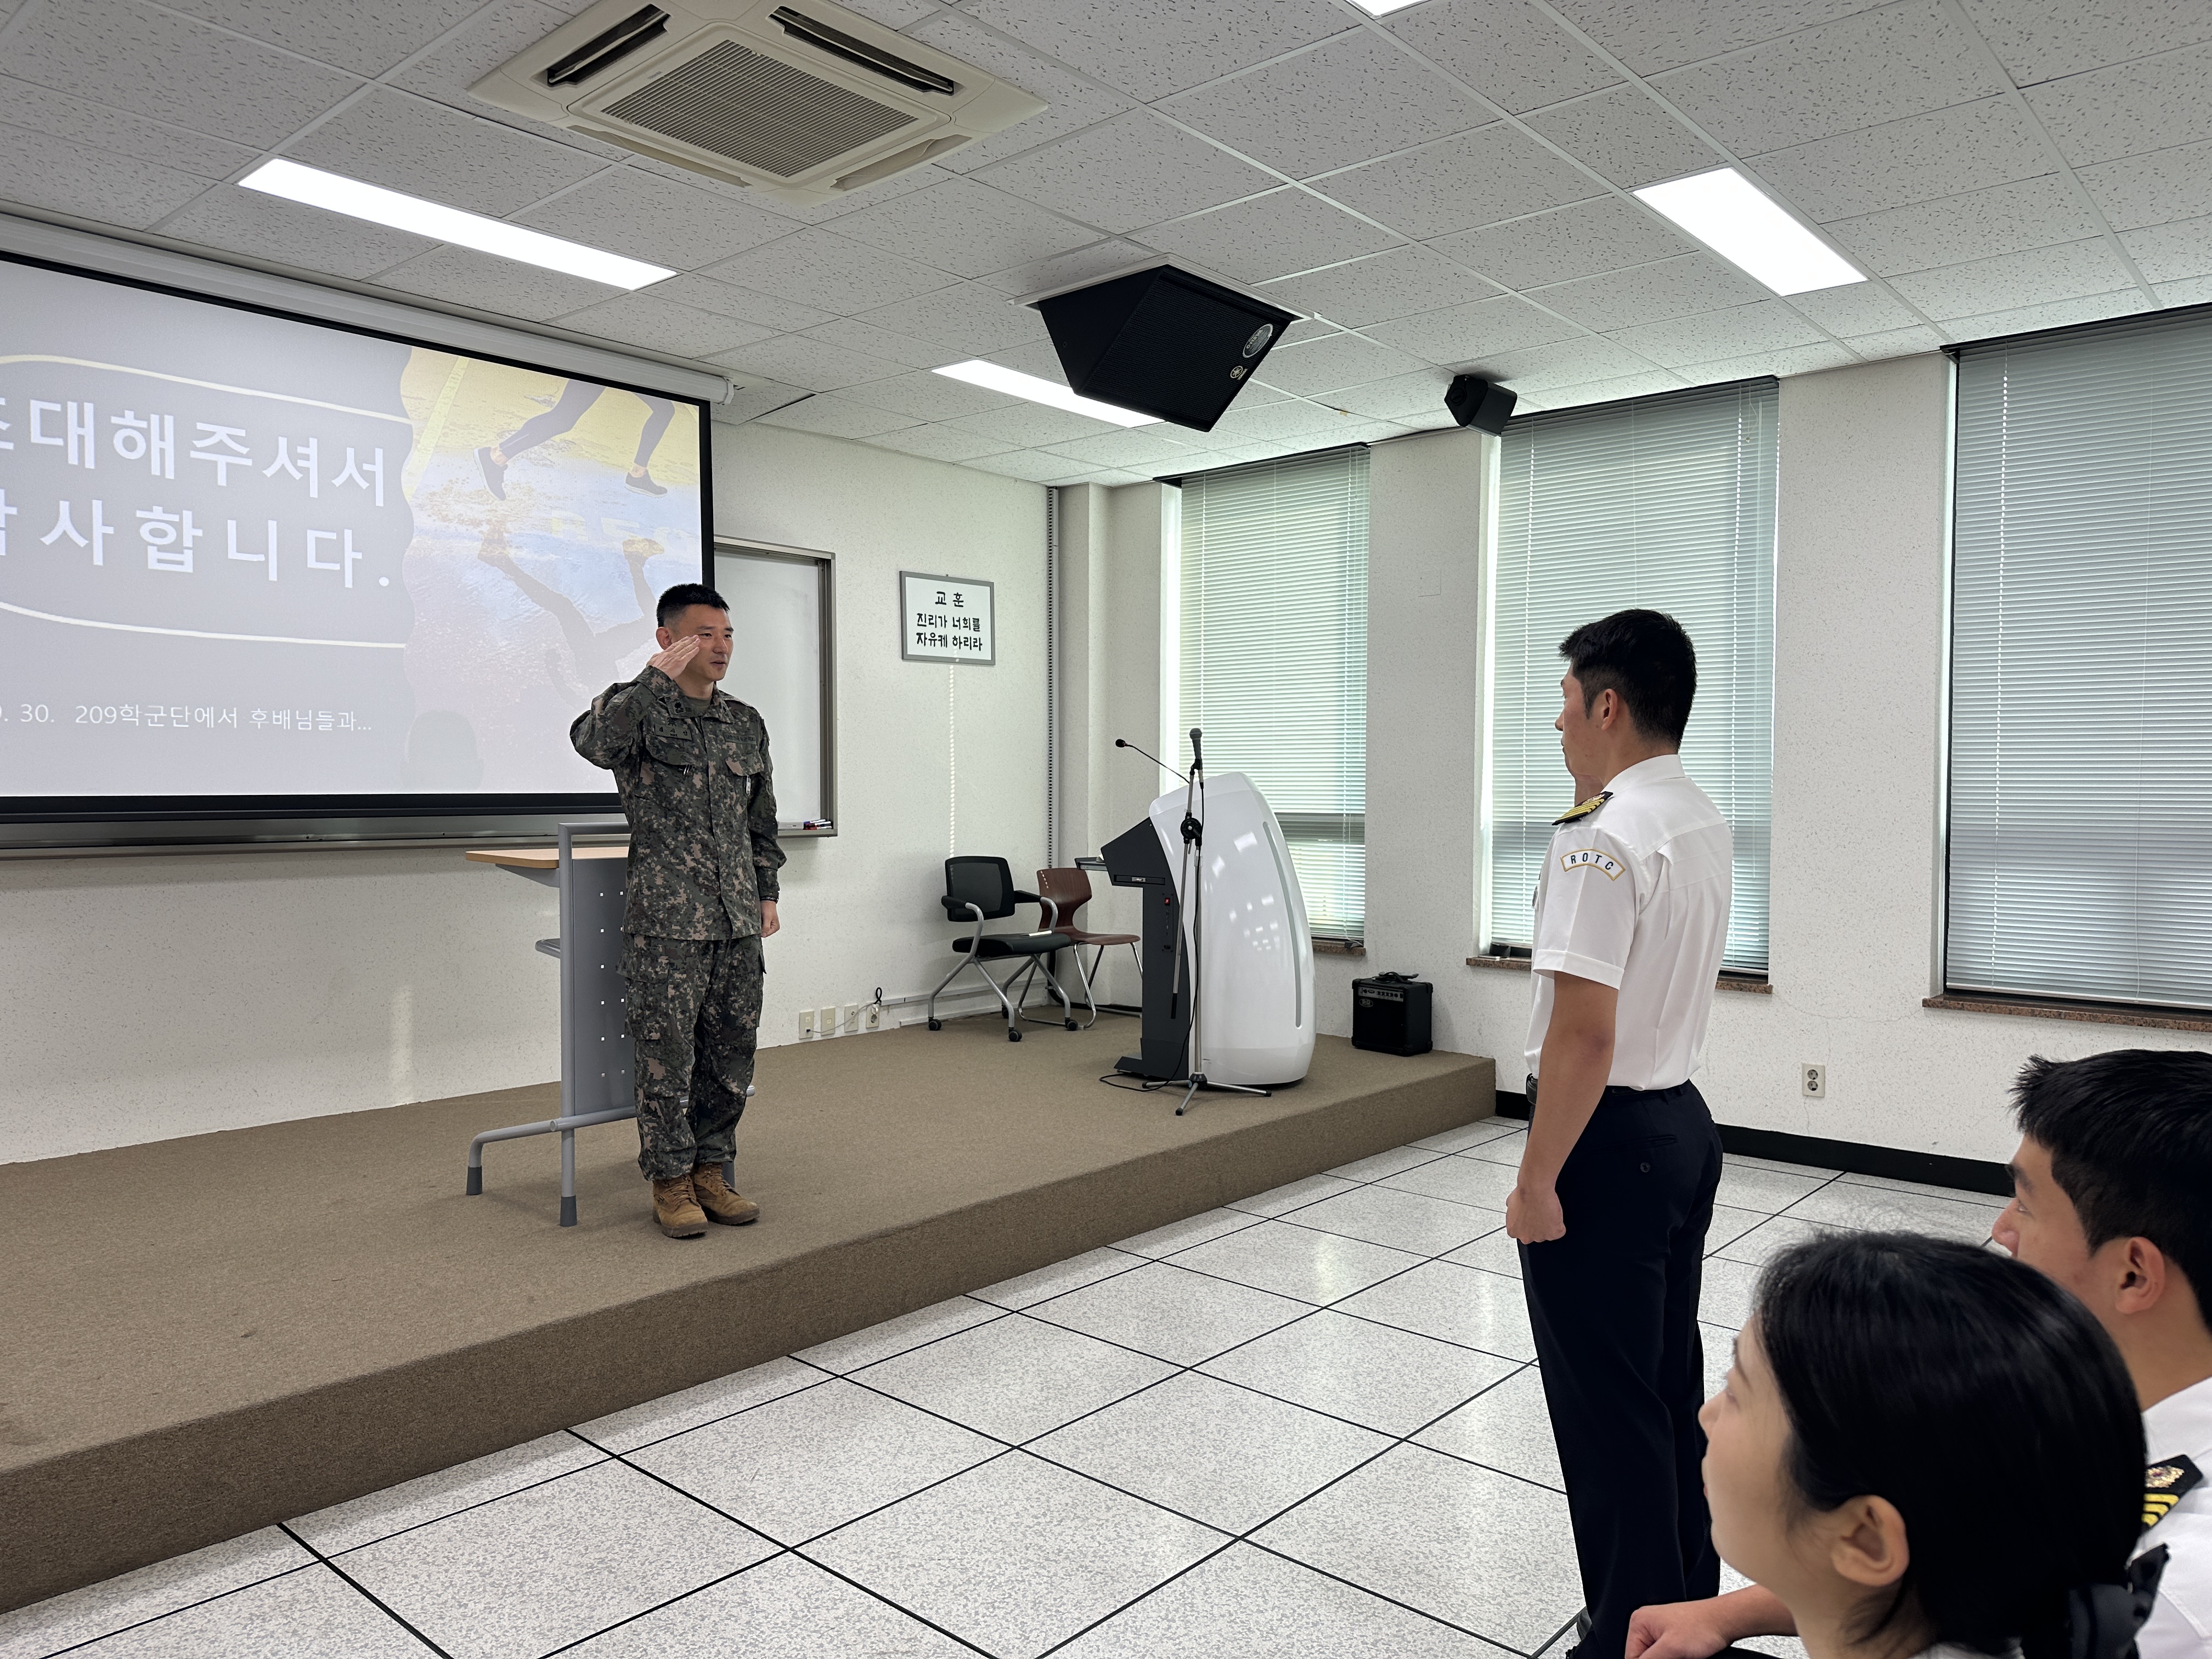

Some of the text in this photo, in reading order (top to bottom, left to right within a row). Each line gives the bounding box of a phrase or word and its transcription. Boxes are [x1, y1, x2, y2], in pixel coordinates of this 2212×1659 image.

[0, 397, 383, 507] 대해주셔서
[0, 488, 389, 589] 사합니다.
[916, 613, 980, 632] 진리가 너희를
[916, 632, 983, 651] 자유케 하리라
[20, 704, 54, 723] 30.
[75, 704, 238, 729] 209학군단에서
[1570, 853, 1614, 870] ROTC
